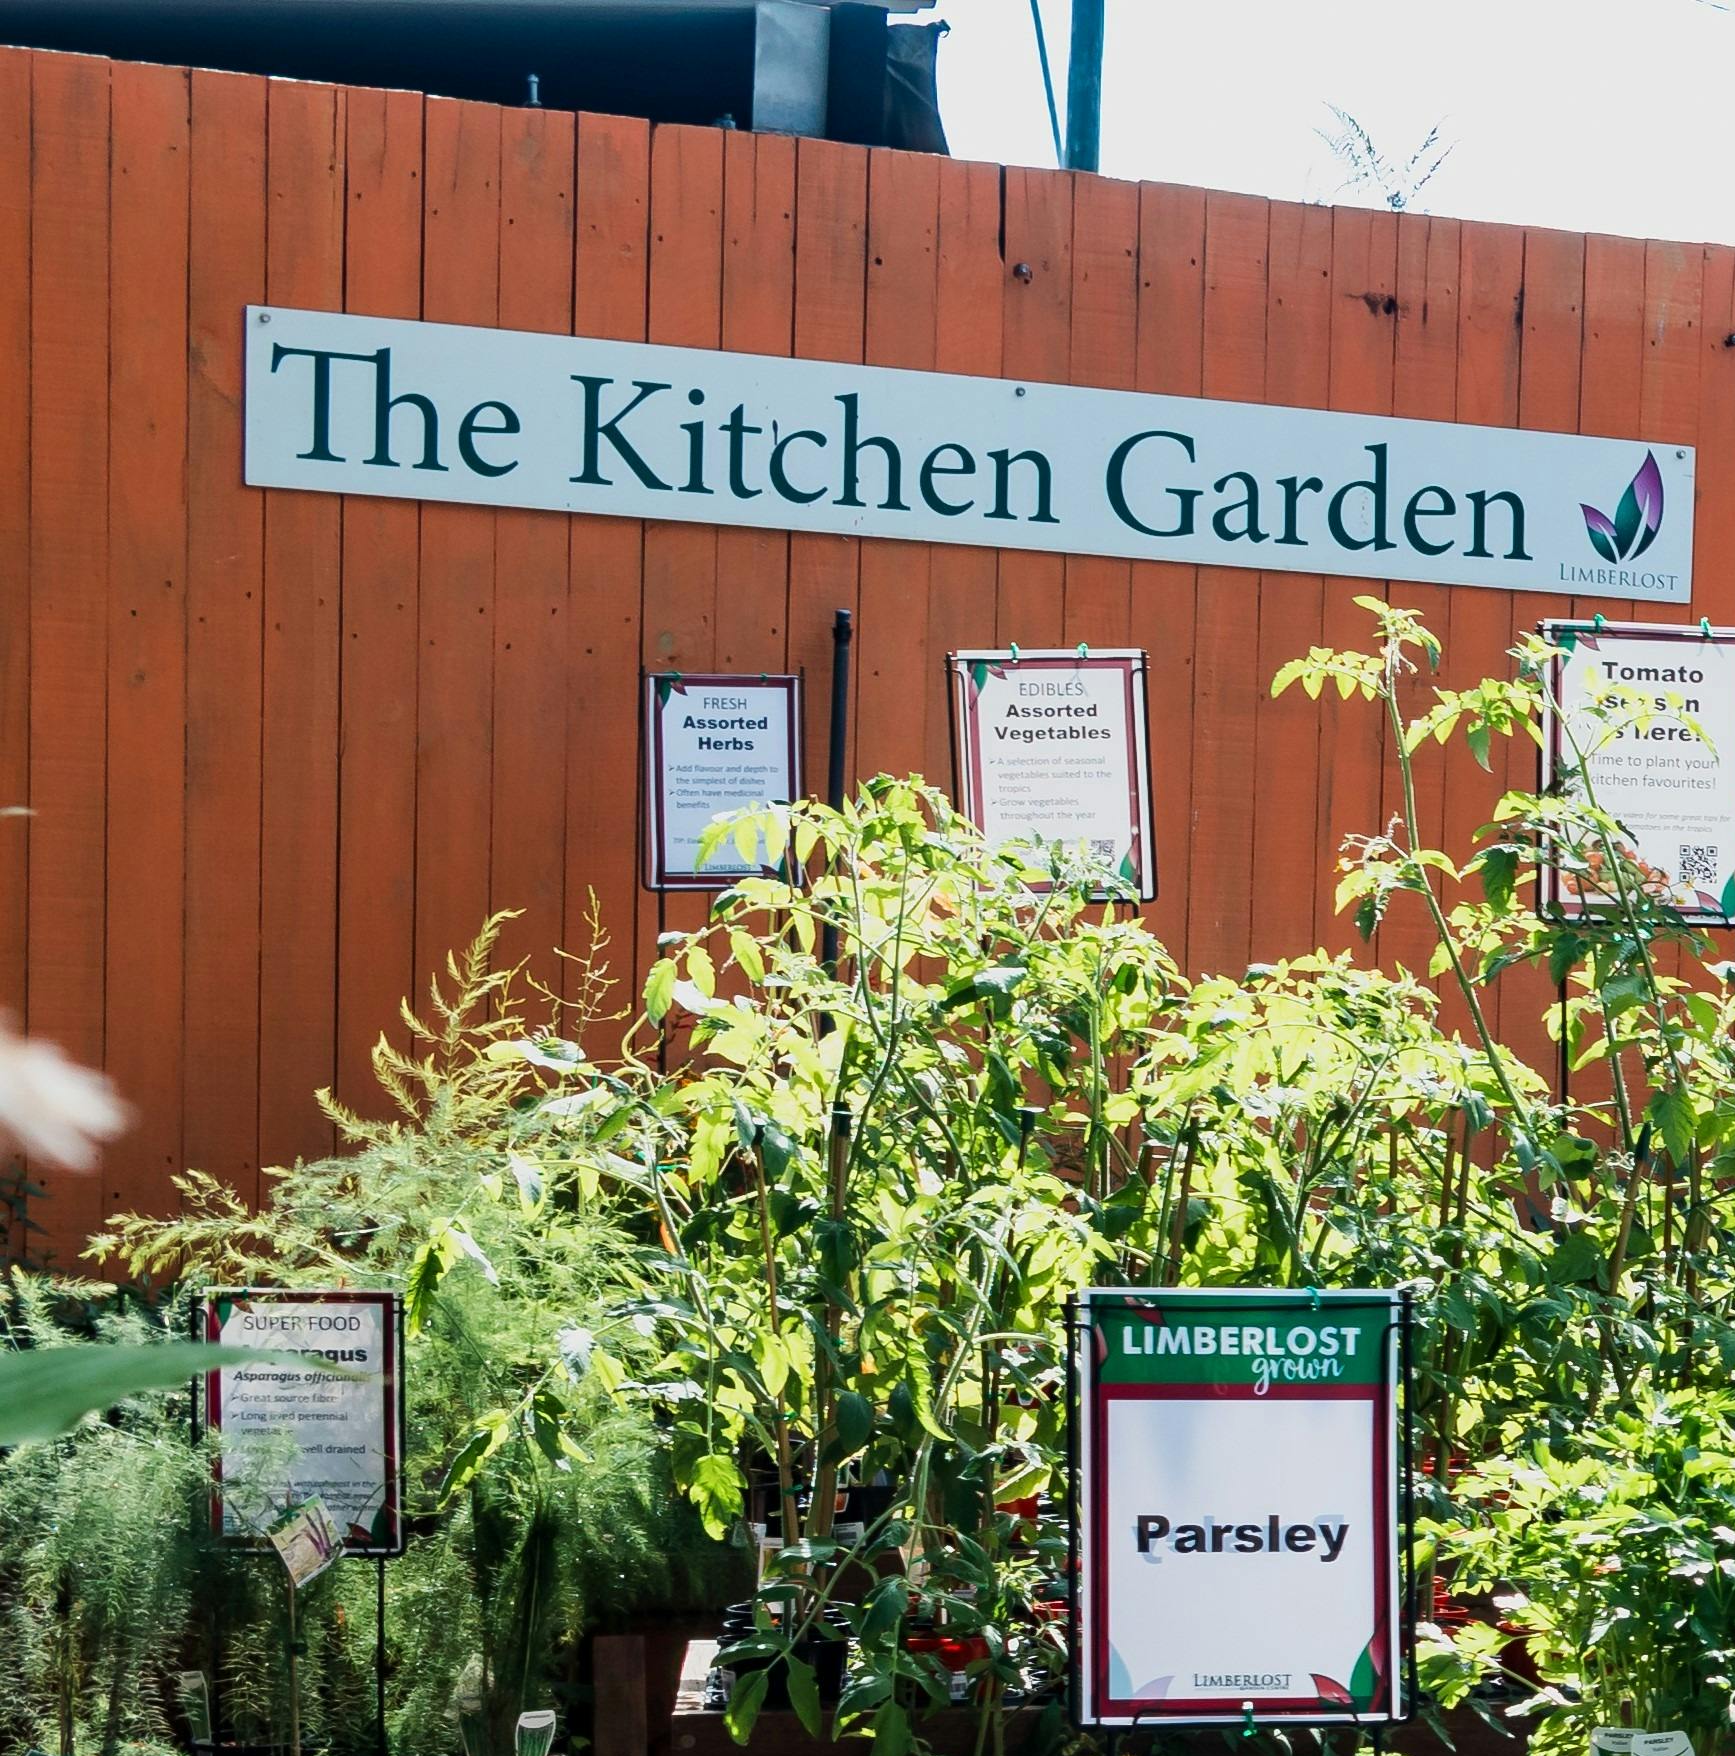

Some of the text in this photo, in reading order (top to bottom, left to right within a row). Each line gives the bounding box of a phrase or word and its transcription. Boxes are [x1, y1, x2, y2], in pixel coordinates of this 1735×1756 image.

[271, 341, 1533, 560] The Kitchen Garden
[1559, 563, 1678, 592] LIMBERLOST
[1602, 662, 1704, 684] Tomato
[1019, 683, 1083, 695] EDIBLES
[703, 697, 746, 709] FRESH
[1006, 704, 1096, 717] Assorted
[683, 716, 767, 728] Assorted
[994, 726, 1110, 742] Vegetables
[698, 737, 753, 749] Herbs
[1007, 756, 1105, 764] selection of seasonal
[1592, 754, 1714, 772] Time to plant your
[744, 766, 767, 774] depth
[998, 770, 1111, 779] vegetables suited to the
[692, 777, 725, 786] simplest
[1643, 775, 1716, 789] favourites!
[998, 784, 1030, 793] tropics
[1000, 798, 1078, 807] Grow vegetables
[1001, 811, 1053, 820] throughout
[1074, 812, 1095, 821] year
[243, 1315, 360, 1331] SUPER FOOD
[1122, 1326, 1361, 1356] LIMBERLOST
[233, 1370, 300, 1383] Asparagus
[1251, 1356, 1344, 1396] grown
[240, 1392, 309, 1403] Great source
[241, 1411, 347, 1422] Long perennial
[326, 1444, 364, 1453] drained
[1136, 1514, 1350, 1563] Parsley
[1193, 1672, 1290, 1687] LIMBERLOST
